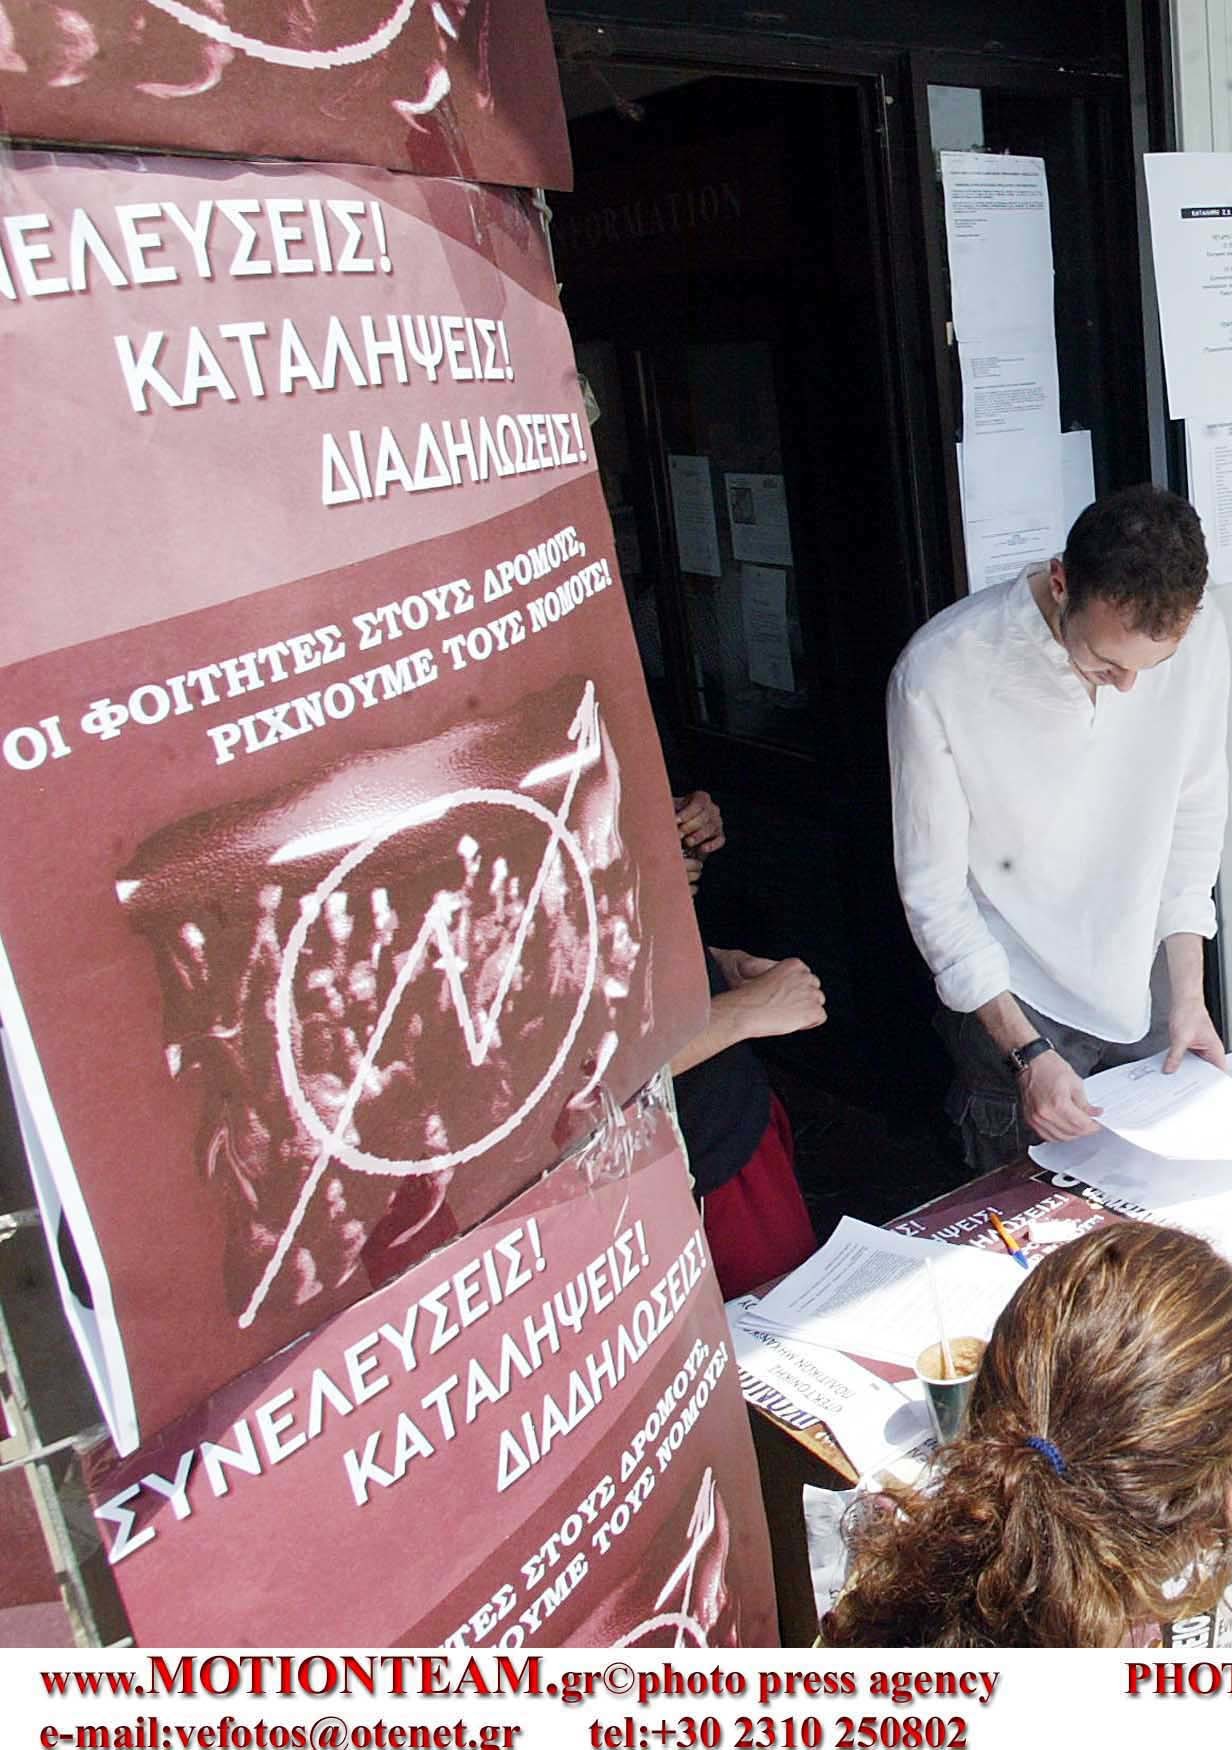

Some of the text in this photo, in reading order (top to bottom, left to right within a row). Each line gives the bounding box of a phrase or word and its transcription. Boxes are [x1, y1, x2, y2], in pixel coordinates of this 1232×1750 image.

[114, 314, 514, 412] ΚΑΤΑΛΗΨΕΙΣ!
[321, 413, 587, 506] ΔΙΑΔΗΛΩΣΕΙΣ!
[3, 525, 587, 771] ΟΙ ΦΟΙΤΗΤΕΣ ΣΤΟΥΣ ΔΡΟΜΟΥΣ,
[207, 559, 613, 765] ΡΙΧΝΟΥΜΕ ΤΟΥΣ ΝΟΜΟΥΣ!
[95, 1217, 548, 1564] ΣΥΝΕΛΕΥΣΕΙΣ!
[344, 1220, 650, 1505] ΚΑΤΑΛΗΨΕΙΣ!
[497, 1230, 707, 1493] ΔΙΑΔΗΛΩΣΕΙΣ!
[521, 1339, 709, 1590] ΣΤΟΥΣ ΔΡΟΜΟΥΣ,
[592, 1466, 656, 1554] ΤΟΥΣ
[656, 1341, 728, 1472] ΝΟΜΟΥΣ!
